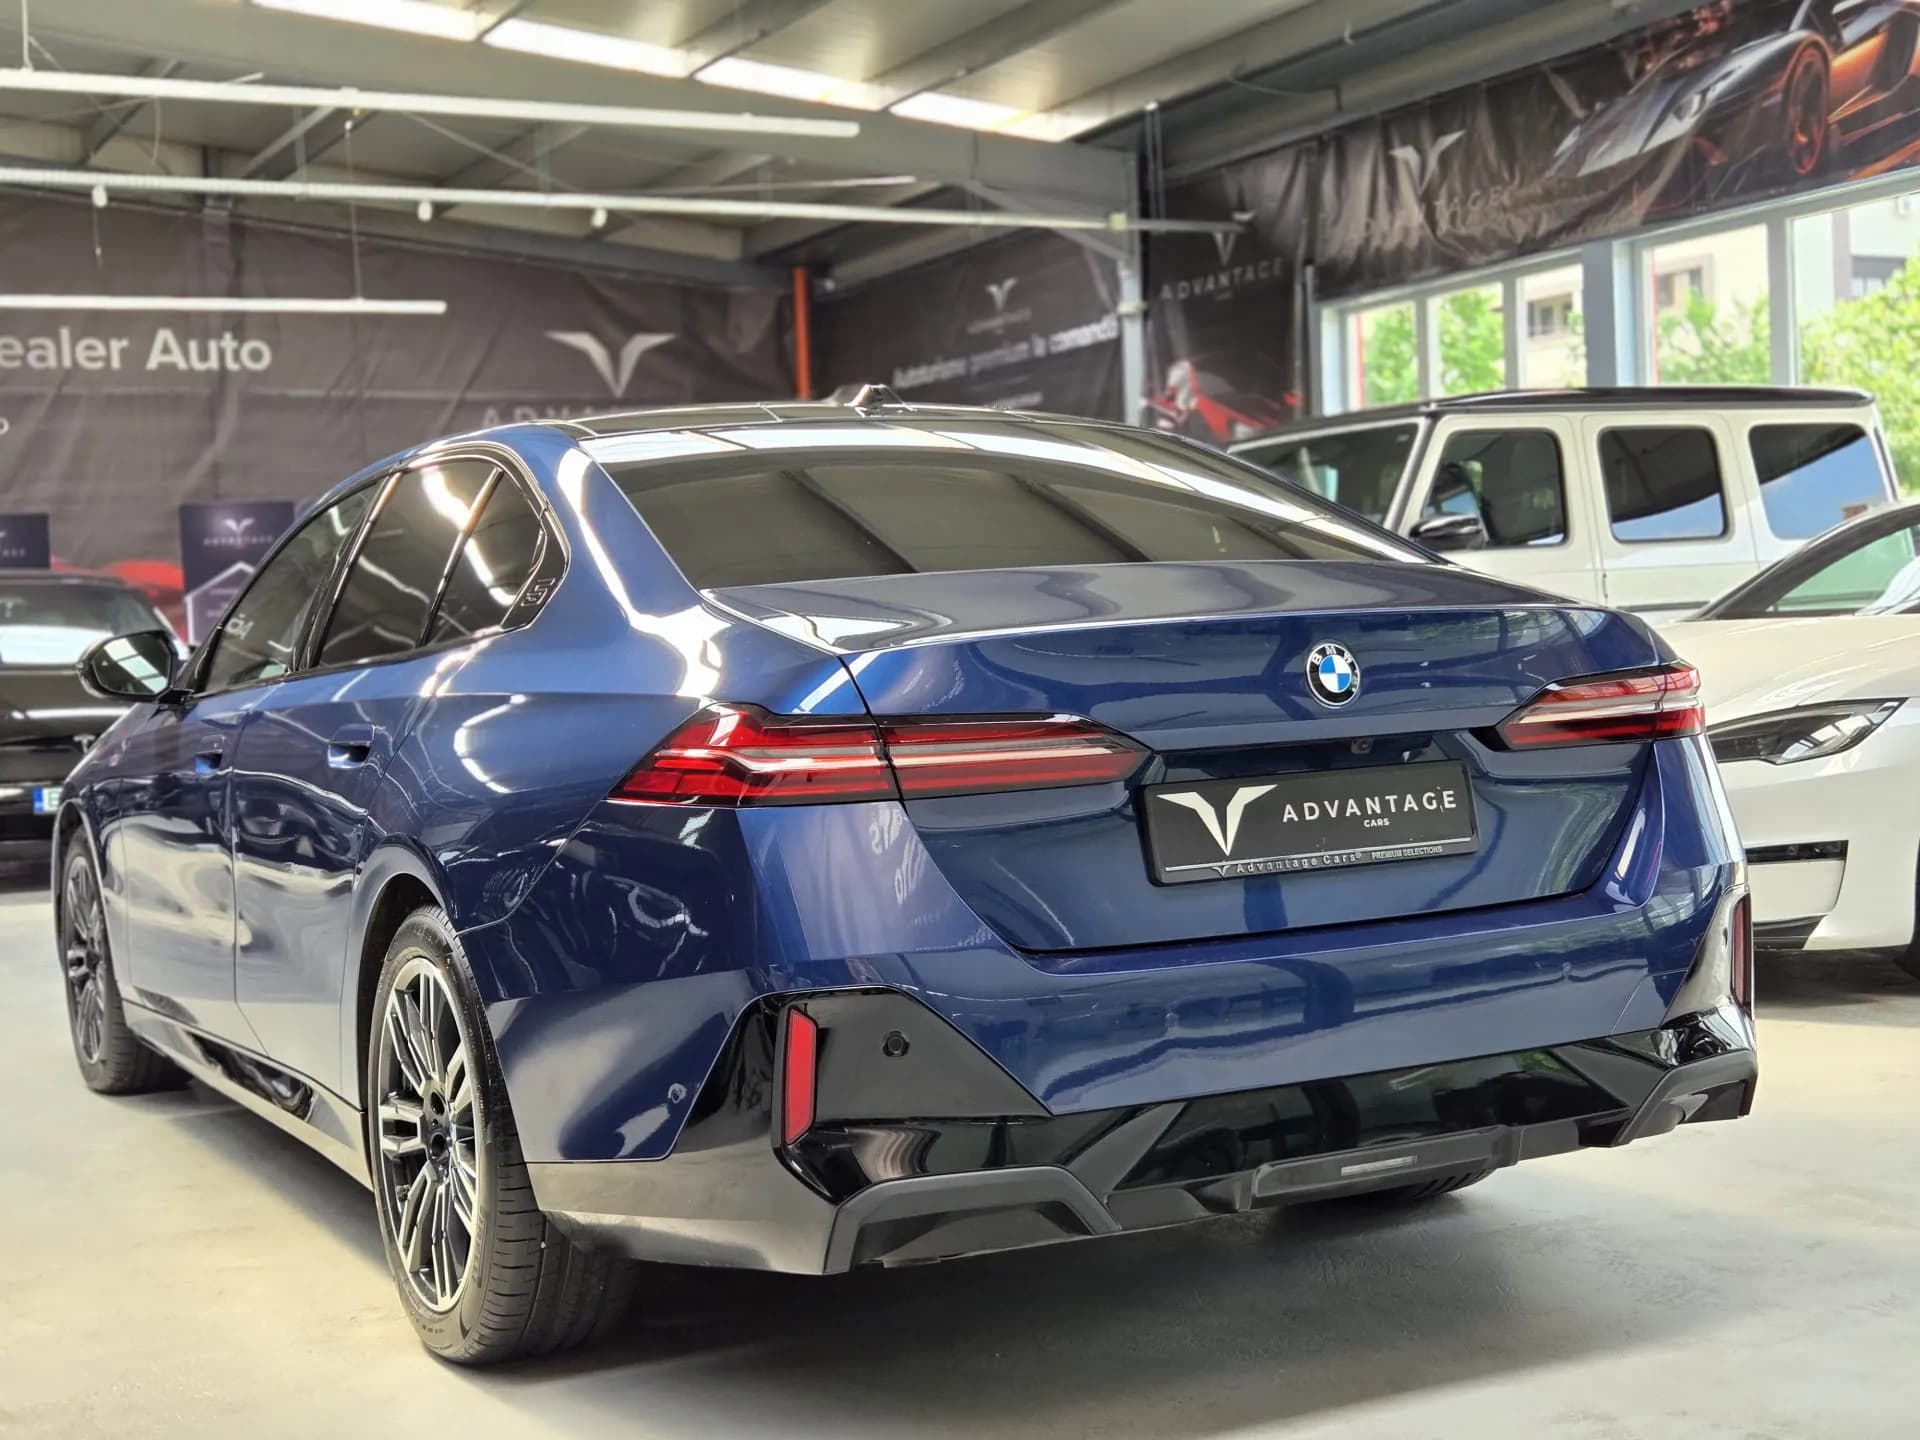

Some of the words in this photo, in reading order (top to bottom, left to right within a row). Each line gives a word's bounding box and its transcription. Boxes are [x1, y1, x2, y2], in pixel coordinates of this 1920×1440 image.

[146, 328, 272, 372] Auto
[1282, 790, 1457, 823] ADVANTAGE
[1363, 817, 1390, 828] CARS
[1236, 857, 1317, 874] Advantage
[1372, 848, 1402, 861] PREMIUM
[1403, 845, 1443, 857] SELECTIONS
